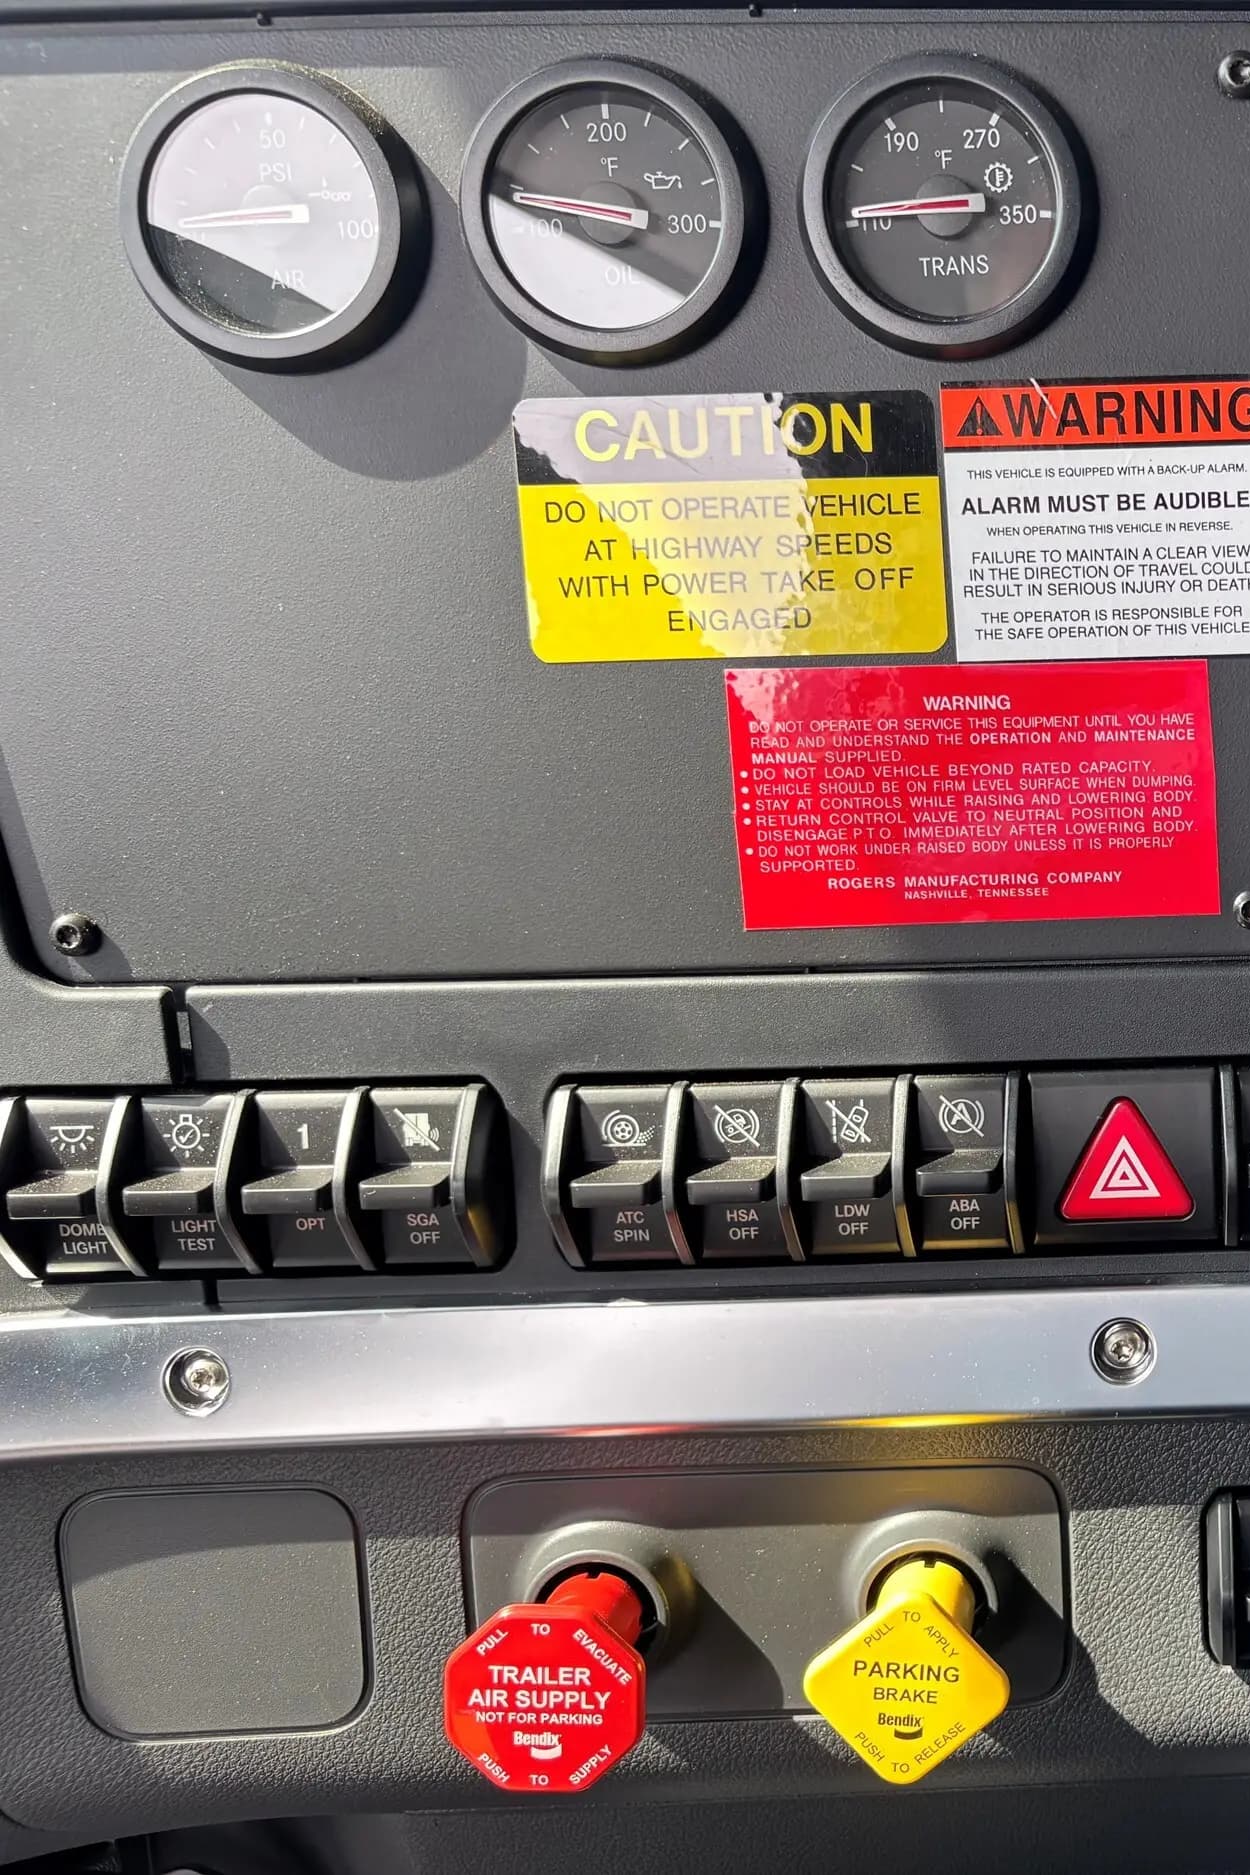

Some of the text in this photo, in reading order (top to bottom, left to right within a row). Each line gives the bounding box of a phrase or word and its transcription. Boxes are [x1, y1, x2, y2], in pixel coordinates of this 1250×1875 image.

[259, 130, 285, 148] 50
[586, 122, 626, 142] 200
[963, 129, 1000, 149] 270
[884, 132, 919, 152] 190
[259, 163, 292, 182] PSI
[667, 214, 706, 234] 300
[1000, 205, 1036, 225] 350
[338, 221, 373, 239] 100
[530, 219, 563, 237] 100
[605, 265, 640, 284] OIL
[919, 255, 989, 277] TRANS
[271, 270, 305, 289] AIR
[574, 402, 874, 463] CAUTION
[545, 492, 921, 523] DO NOT OPERATE VEHICLE
[961, 497, 1040, 515] ALARM
[1047, 494, 1109, 513] MUST
[1117, 493, 1146, 511] BE
[584, 532, 892, 561] AT HIGHWAY SPEEDS
[972, 544, 1250, 565] FAILURE TO MAINTAIN A CLEAR VIEW
[559, 567, 915, 598] WITH POWER TAKE OFF
[668, 607, 811, 632] ENGAGED
[923, 695, 1011, 711] WARNING
[751, 750, 907, 764] MANUAL SUPPLIED.
[753, 760, 1156, 780] DO NOT LOAD VEHICLE BEYOND RATED CAPACITY.
[760, 860, 860, 873] SUPPORTED.
[827, 871, 1122, 889] ROGERS MANUFACTURING COMPANY
[978, 888, 1049, 897] TENNESSEE
[297, 1123, 310, 1150] 1
[834, 1204, 870, 1219] LDW
[948, 1199, 981, 1213] ABA
[296, 1217, 325, 1232] OPT
[406, 1213, 440, 1227] SGA
[616, 1211, 645, 1224] ATC
[726, 1209, 758, 1222] HSA
[950, 1216, 981, 1231] OFF
[59, 1223, 107, 1238] DOME
[171, 1219, 217, 1234] LIGHT
[613, 1228, 651, 1243] SPIN
[729, 1226, 759, 1240] OFF
[838, 1221, 869, 1235] OFF
[178, 1237, 216, 1252] TEST
[409, 1230, 441, 1245] OFF
[63, 1240, 109, 1256] LIGHT
[863, 1611, 960, 1658] PULL TO APPLY
[476, 1623, 633, 1685] PULL TO EVACUATE
[488, 1665, 591, 1686] TRAILER
[853, 1660, 960, 1683] PARKING
[468, 1688, 611, 1710] AIR SUPPLY
[873, 1687, 938, 1704] BRAKE
[476, 1711, 603, 1725] NOT FOR PARKING
[877, 1712, 921, 1728] Bendix
[513, 1731, 560, 1746] Bendix
[854, 1722, 966, 1774] PUSH TO RELEASE
[477, 1745, 612, 1786] PUSH TO SUPPLY
